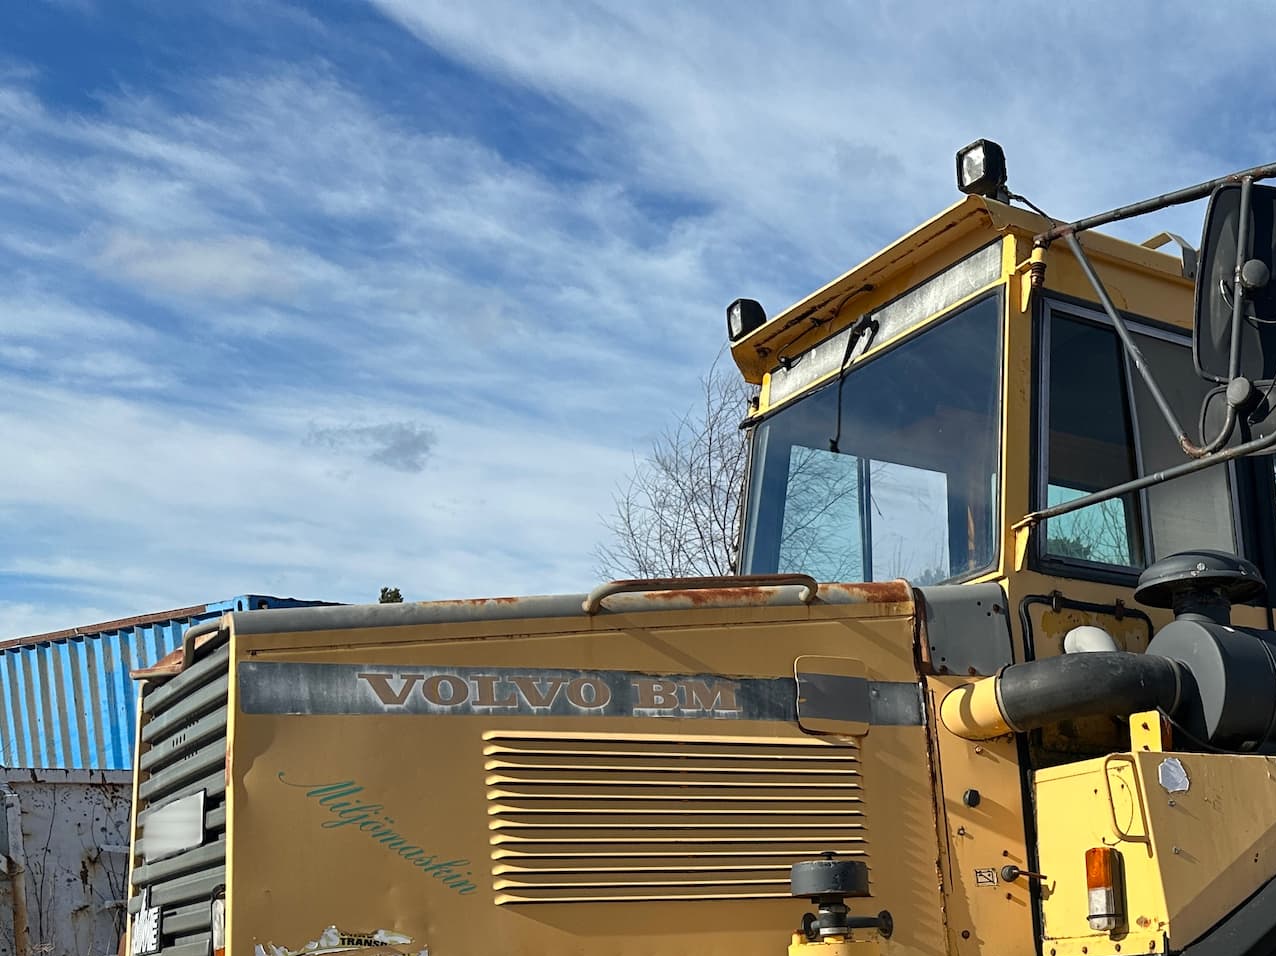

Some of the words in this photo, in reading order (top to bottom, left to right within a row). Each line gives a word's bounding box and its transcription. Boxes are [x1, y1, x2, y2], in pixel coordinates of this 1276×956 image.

[357, 672, 612, 710] VOLVO
[632, 678, 743, 713] BM
[277, 771, 478, 896] Miljömaskin
